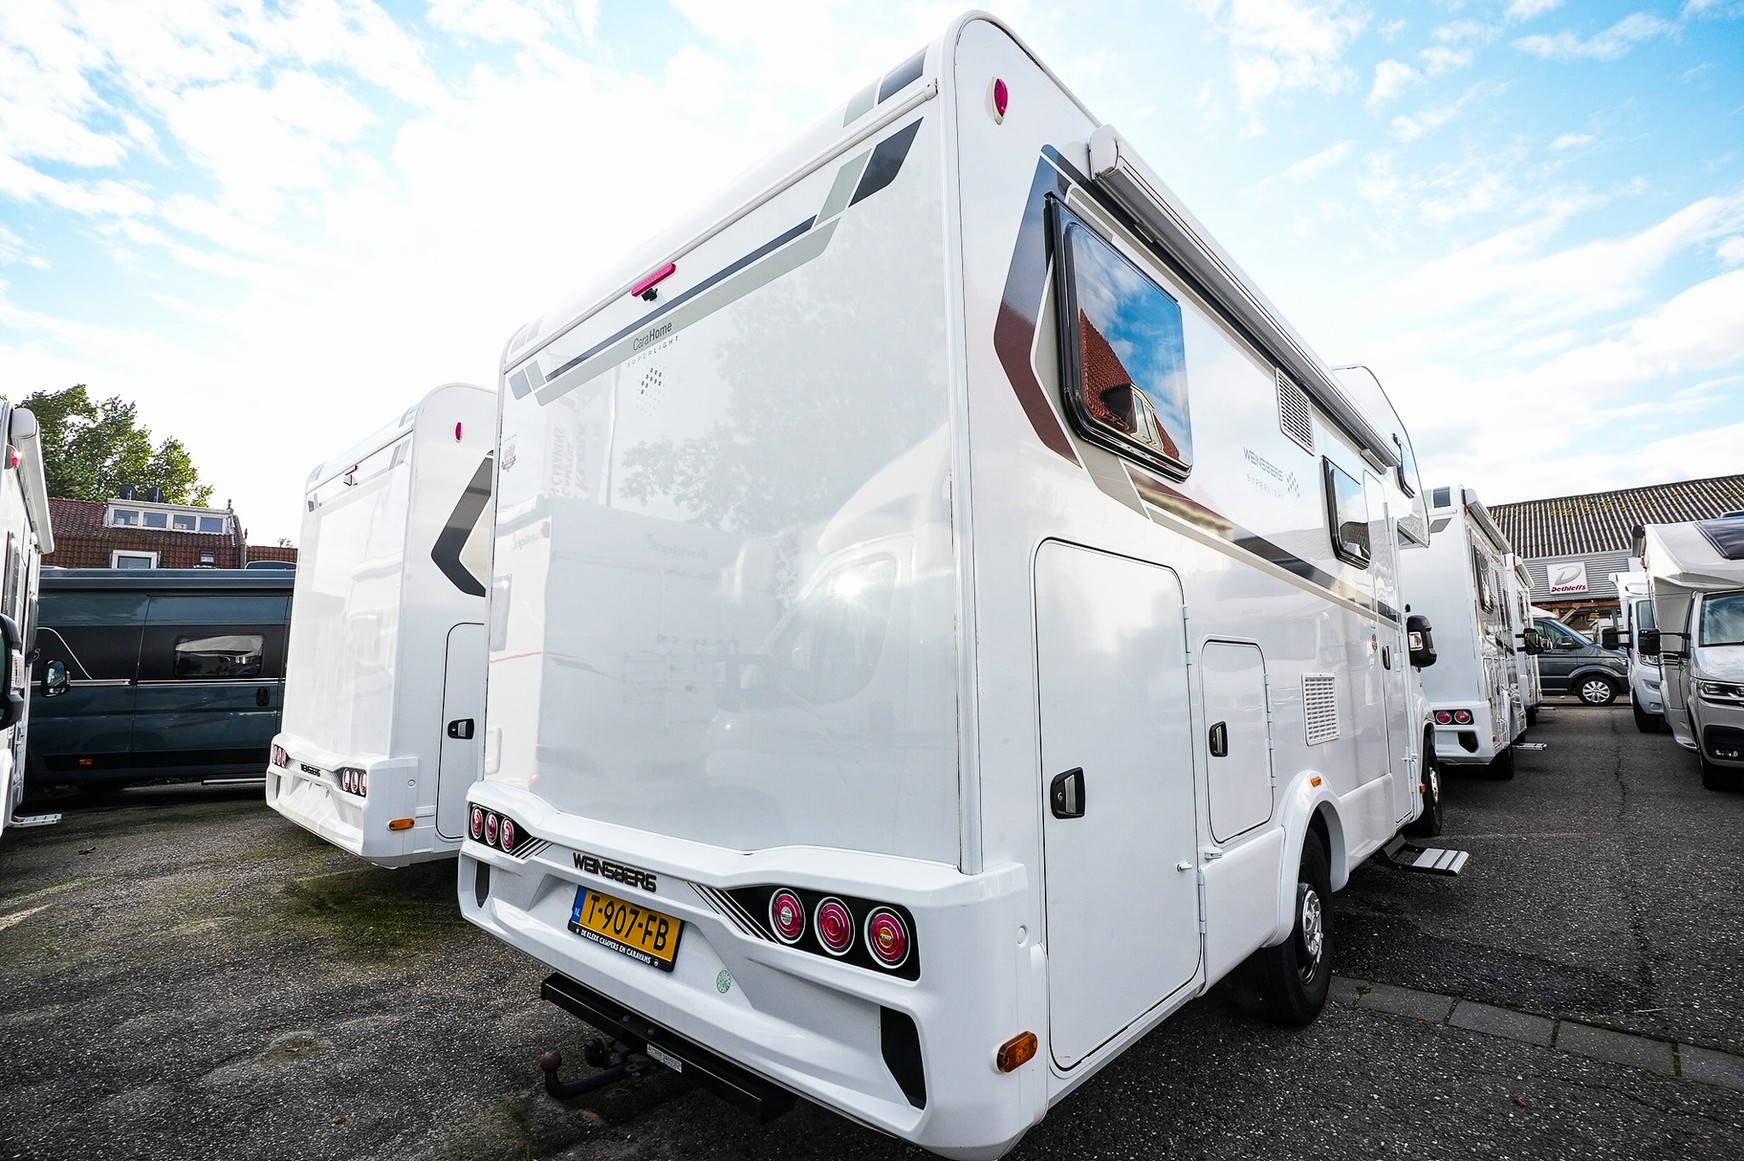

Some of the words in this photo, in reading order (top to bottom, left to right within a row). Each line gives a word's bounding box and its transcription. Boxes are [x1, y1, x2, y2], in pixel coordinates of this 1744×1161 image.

[626, 335, 680, 367] SUPERLIGHT
[632, 321, 672, 351] CaraHome
[1242, 446, 1284, 482] WEINSBERG
[1551, 584, 1587, 592] Dethleffs
[572, 852, 658, 893] WEINSBERG
[573, 907, 580, 917] NL
[588, 894, 670, 951] T-907-FB
[599, 937, 619, 951] CAMPERS
[619, 945, 626, 954] EN
[626, 948, 652, 965] CARAVANS
